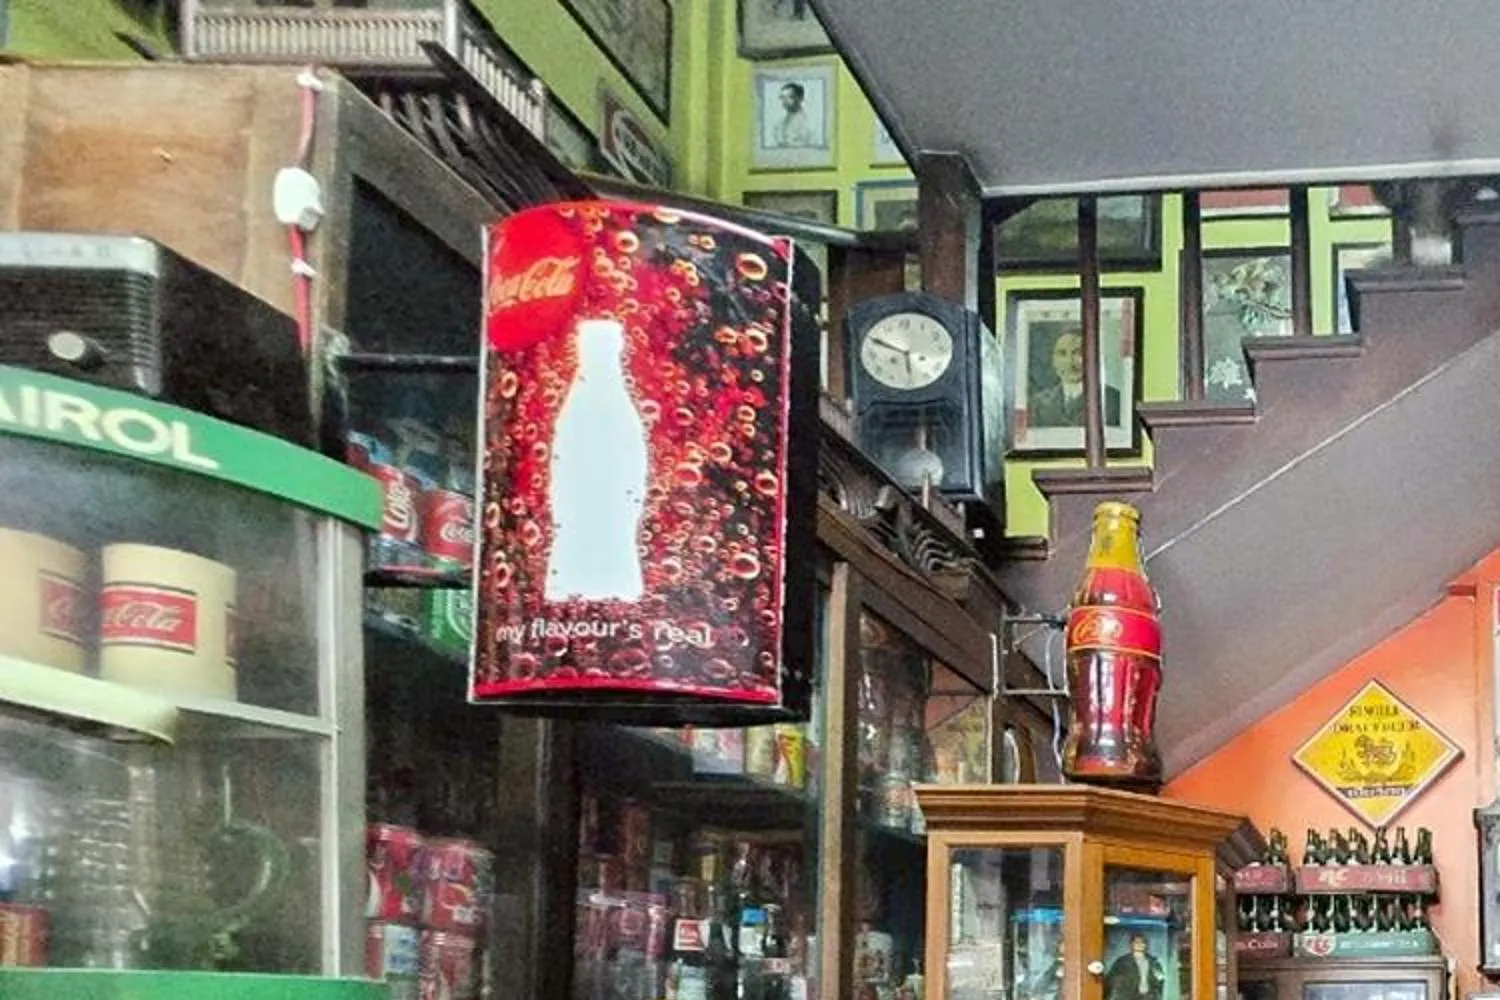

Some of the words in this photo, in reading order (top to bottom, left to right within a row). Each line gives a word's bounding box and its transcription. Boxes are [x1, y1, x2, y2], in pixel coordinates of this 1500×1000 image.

[495, 627, 526, 645] my
[531, 617, 642, 640] flavour's
[654, 619, 713, 645] real
